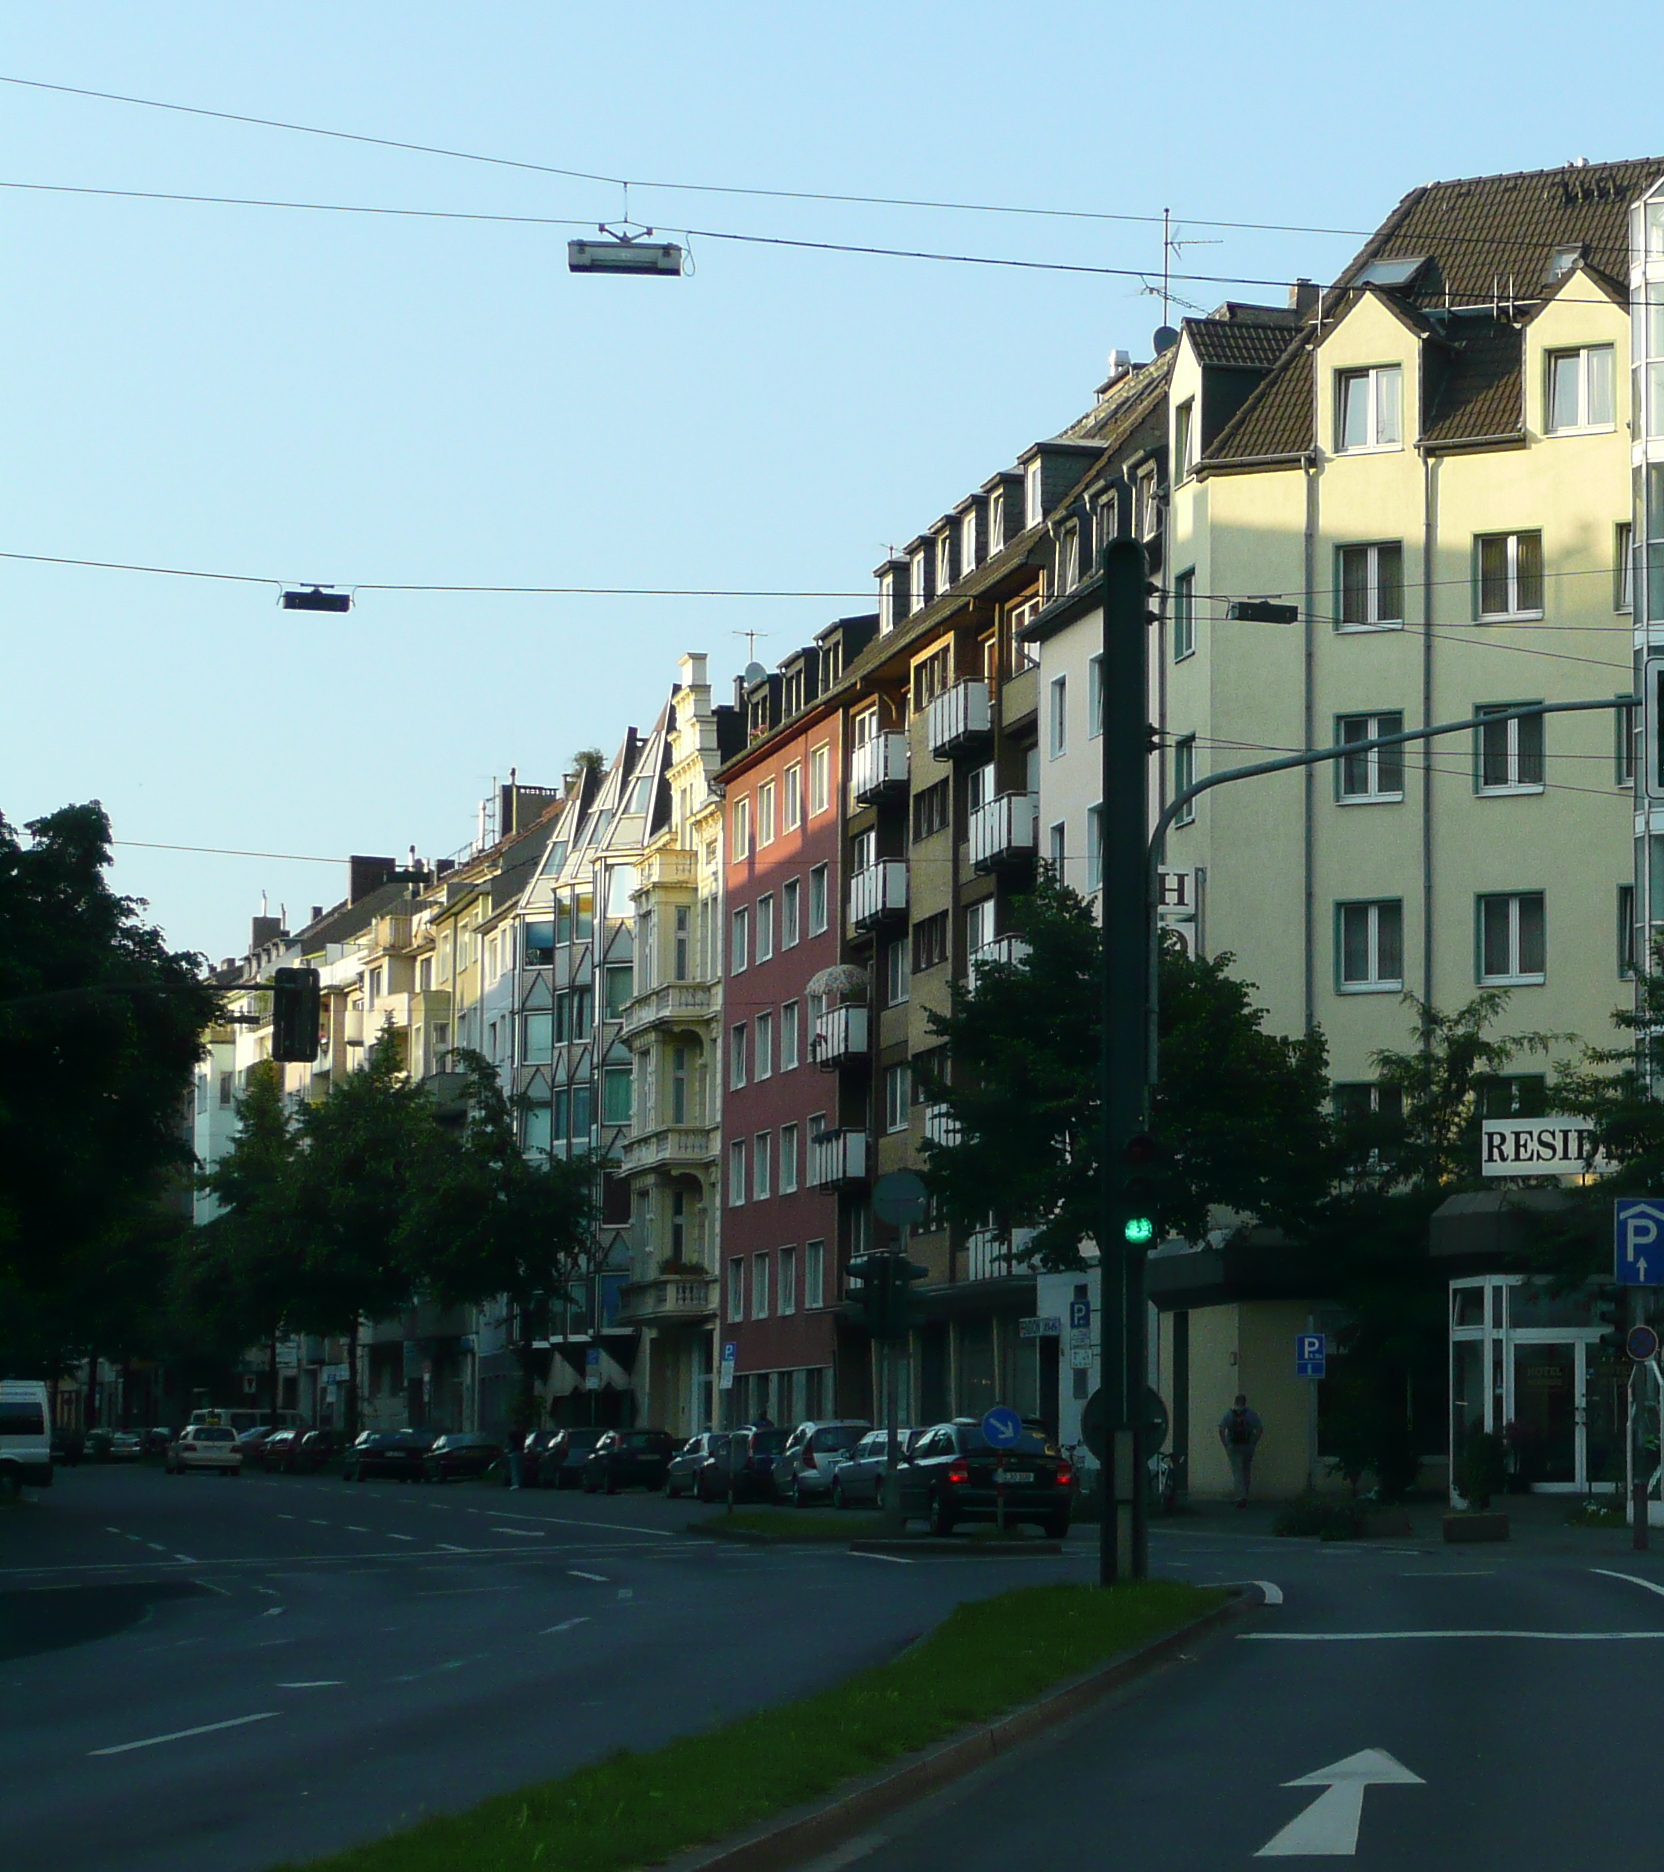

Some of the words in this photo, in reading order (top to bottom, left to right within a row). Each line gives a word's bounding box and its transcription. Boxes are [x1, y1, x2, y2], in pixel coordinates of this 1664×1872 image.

[1484, 1129, 1614, 1163] RESID
[1627, 1218, 1657, 1262] P
[1074, 1304, 1086, 1325] P
[1304, 1337, 1320, 1359] P
